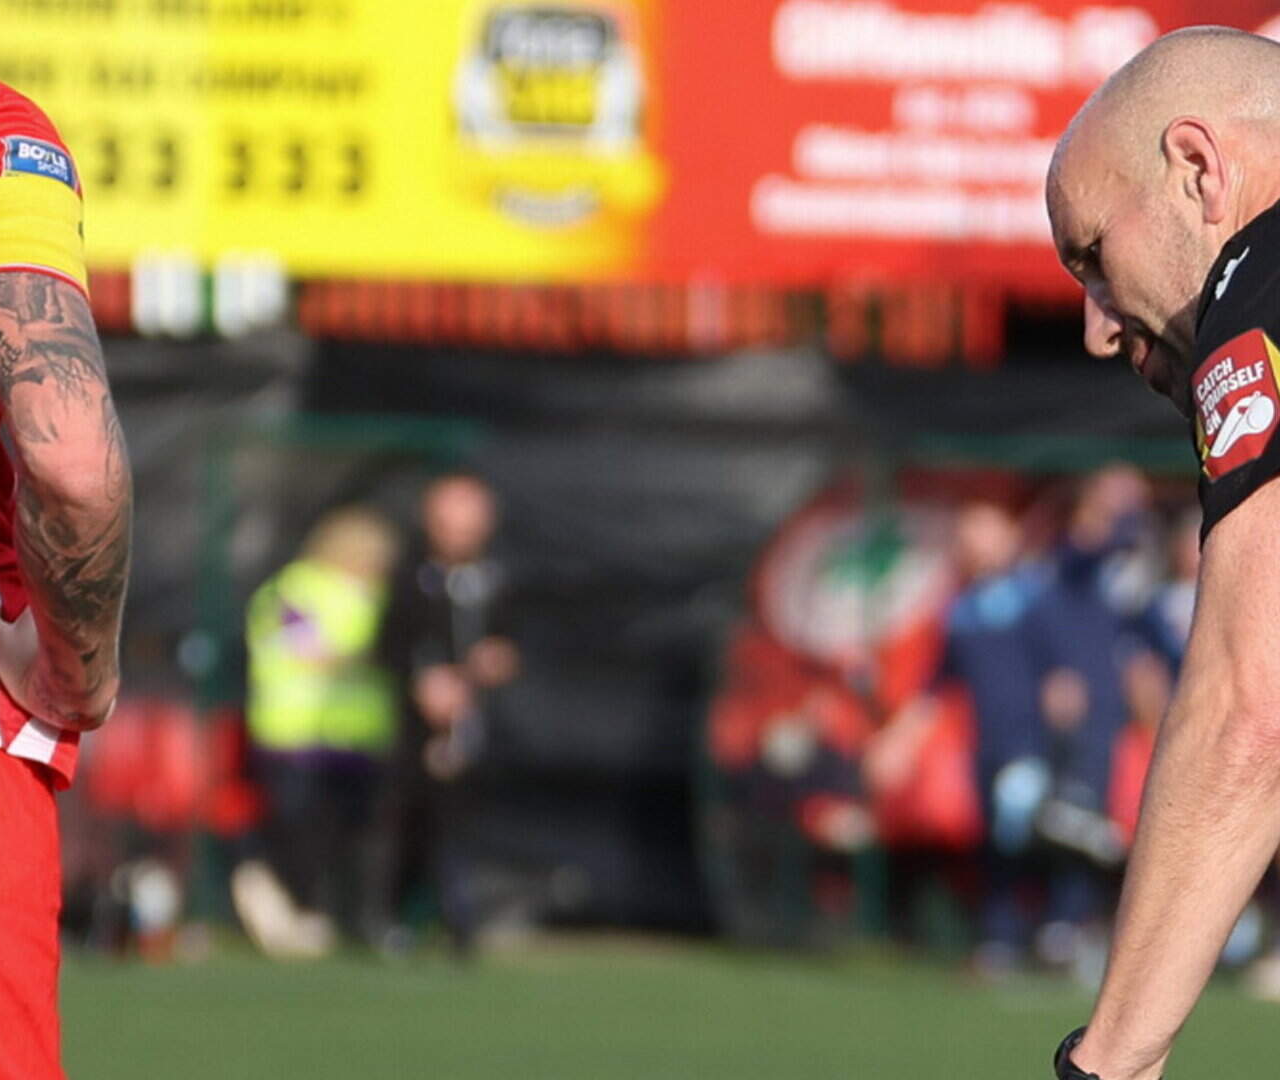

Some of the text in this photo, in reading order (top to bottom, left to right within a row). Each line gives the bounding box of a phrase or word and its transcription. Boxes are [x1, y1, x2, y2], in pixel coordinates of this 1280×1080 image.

[18, 142, 68, 170] BOYLE
[1197, 357, 1233, 401] CATCH
[1202, 360, 1264, 418] YOURSELF
[1206, 409, 1222, 436] ON
